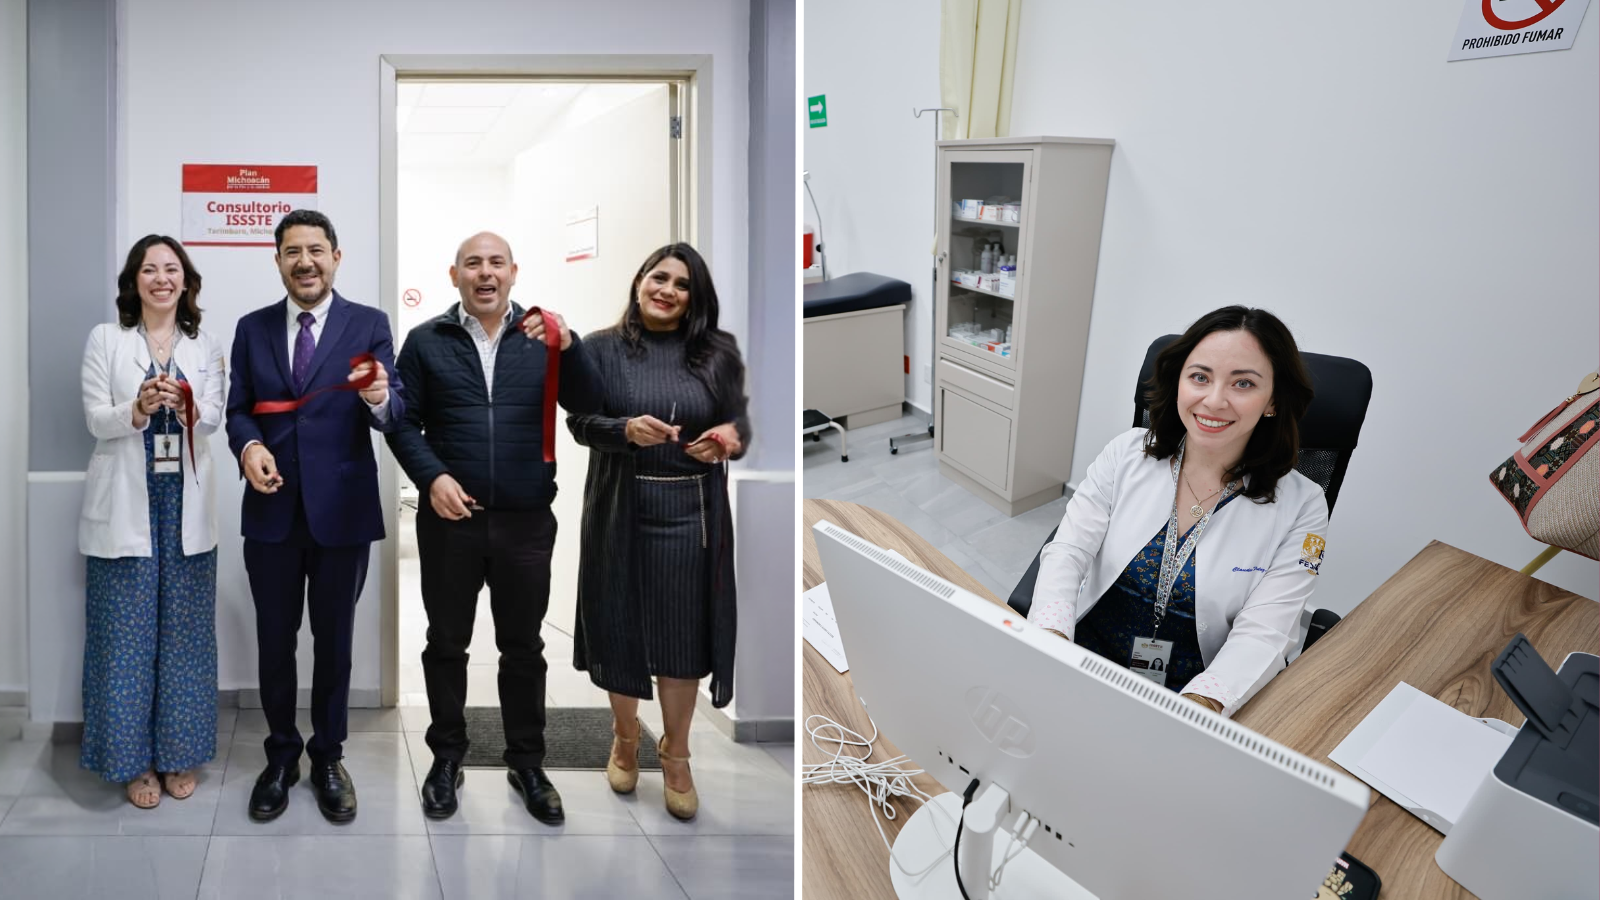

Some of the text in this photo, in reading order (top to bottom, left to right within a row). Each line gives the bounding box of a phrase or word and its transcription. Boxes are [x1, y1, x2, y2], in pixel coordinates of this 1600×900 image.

[1462, 27, 1564, 50] PROHIBIDO FUMAR
[227, 176, 270, 184] Michoacán
[207, 201, 291, 213] Consultorio
[226, 214, 272, 226] ISSSTE
